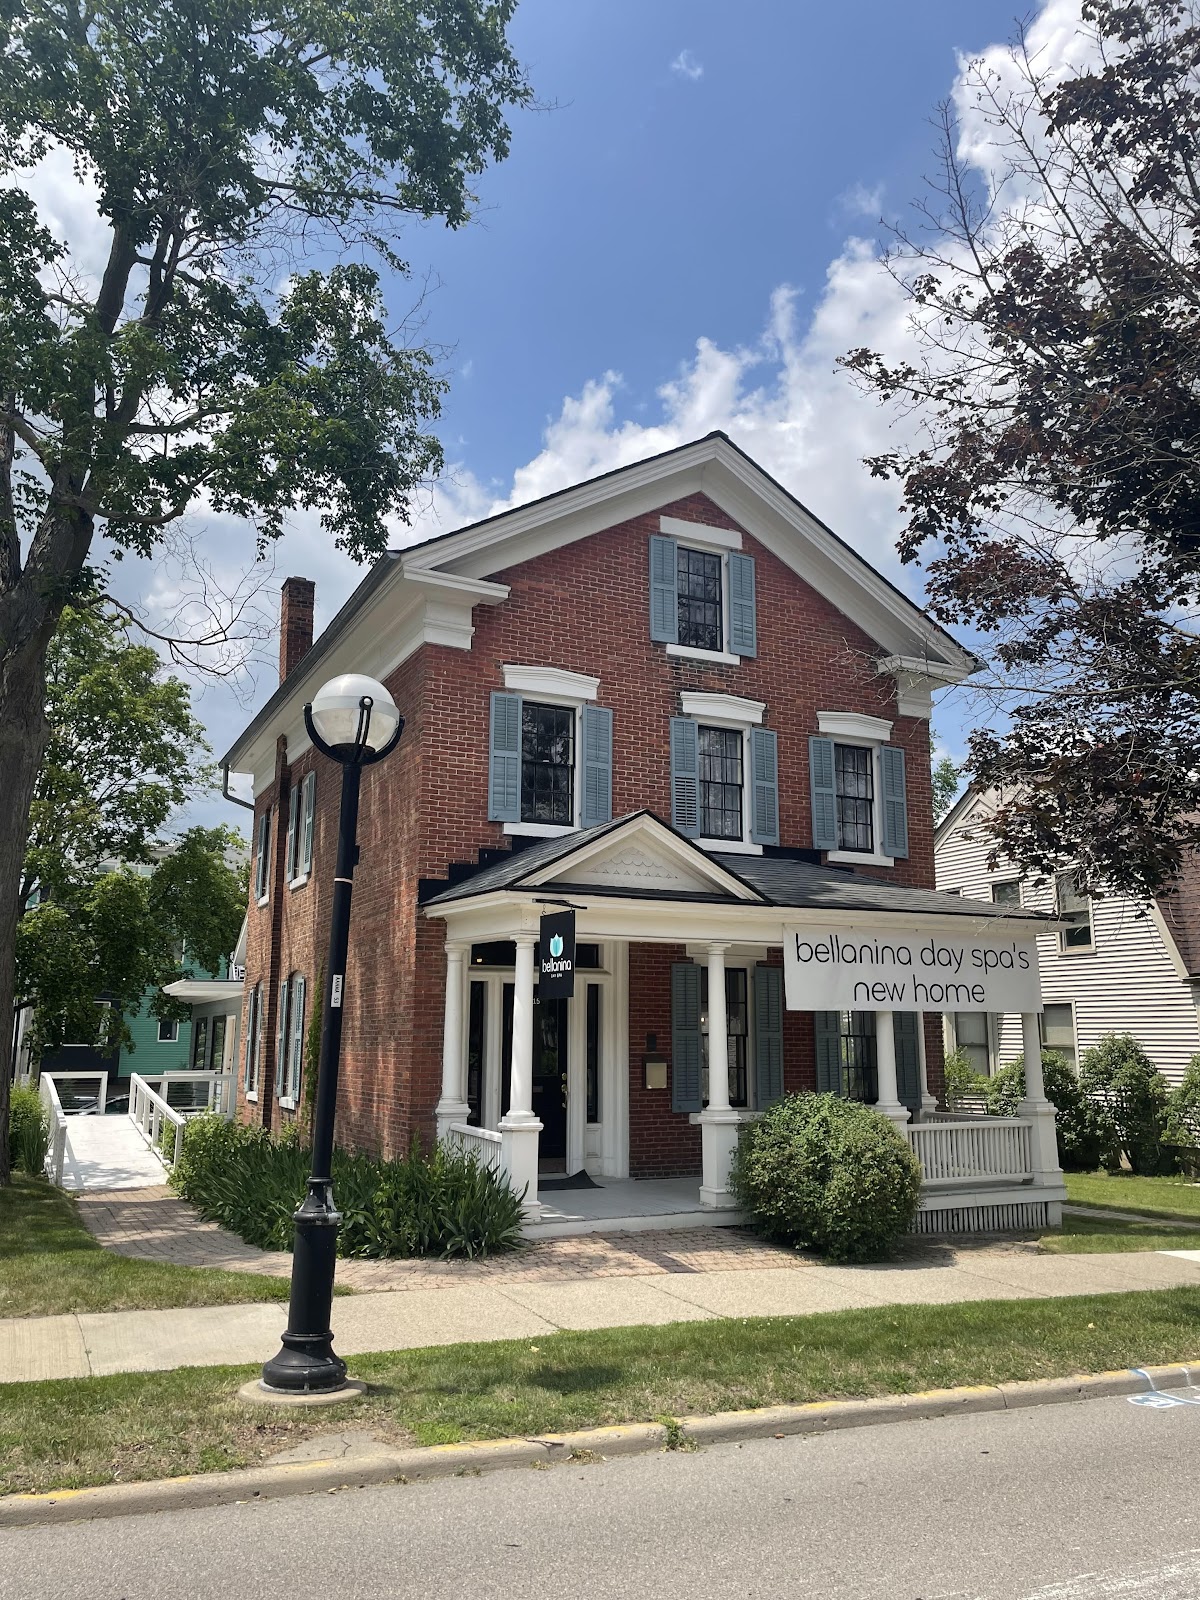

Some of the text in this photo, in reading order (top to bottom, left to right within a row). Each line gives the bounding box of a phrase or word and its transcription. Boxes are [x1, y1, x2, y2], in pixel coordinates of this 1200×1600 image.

[542, 958, 571, 972] bellanina
[795, 932, 1030, 975] bellanina day spa's
[853, 974, 985, 1003] new home
